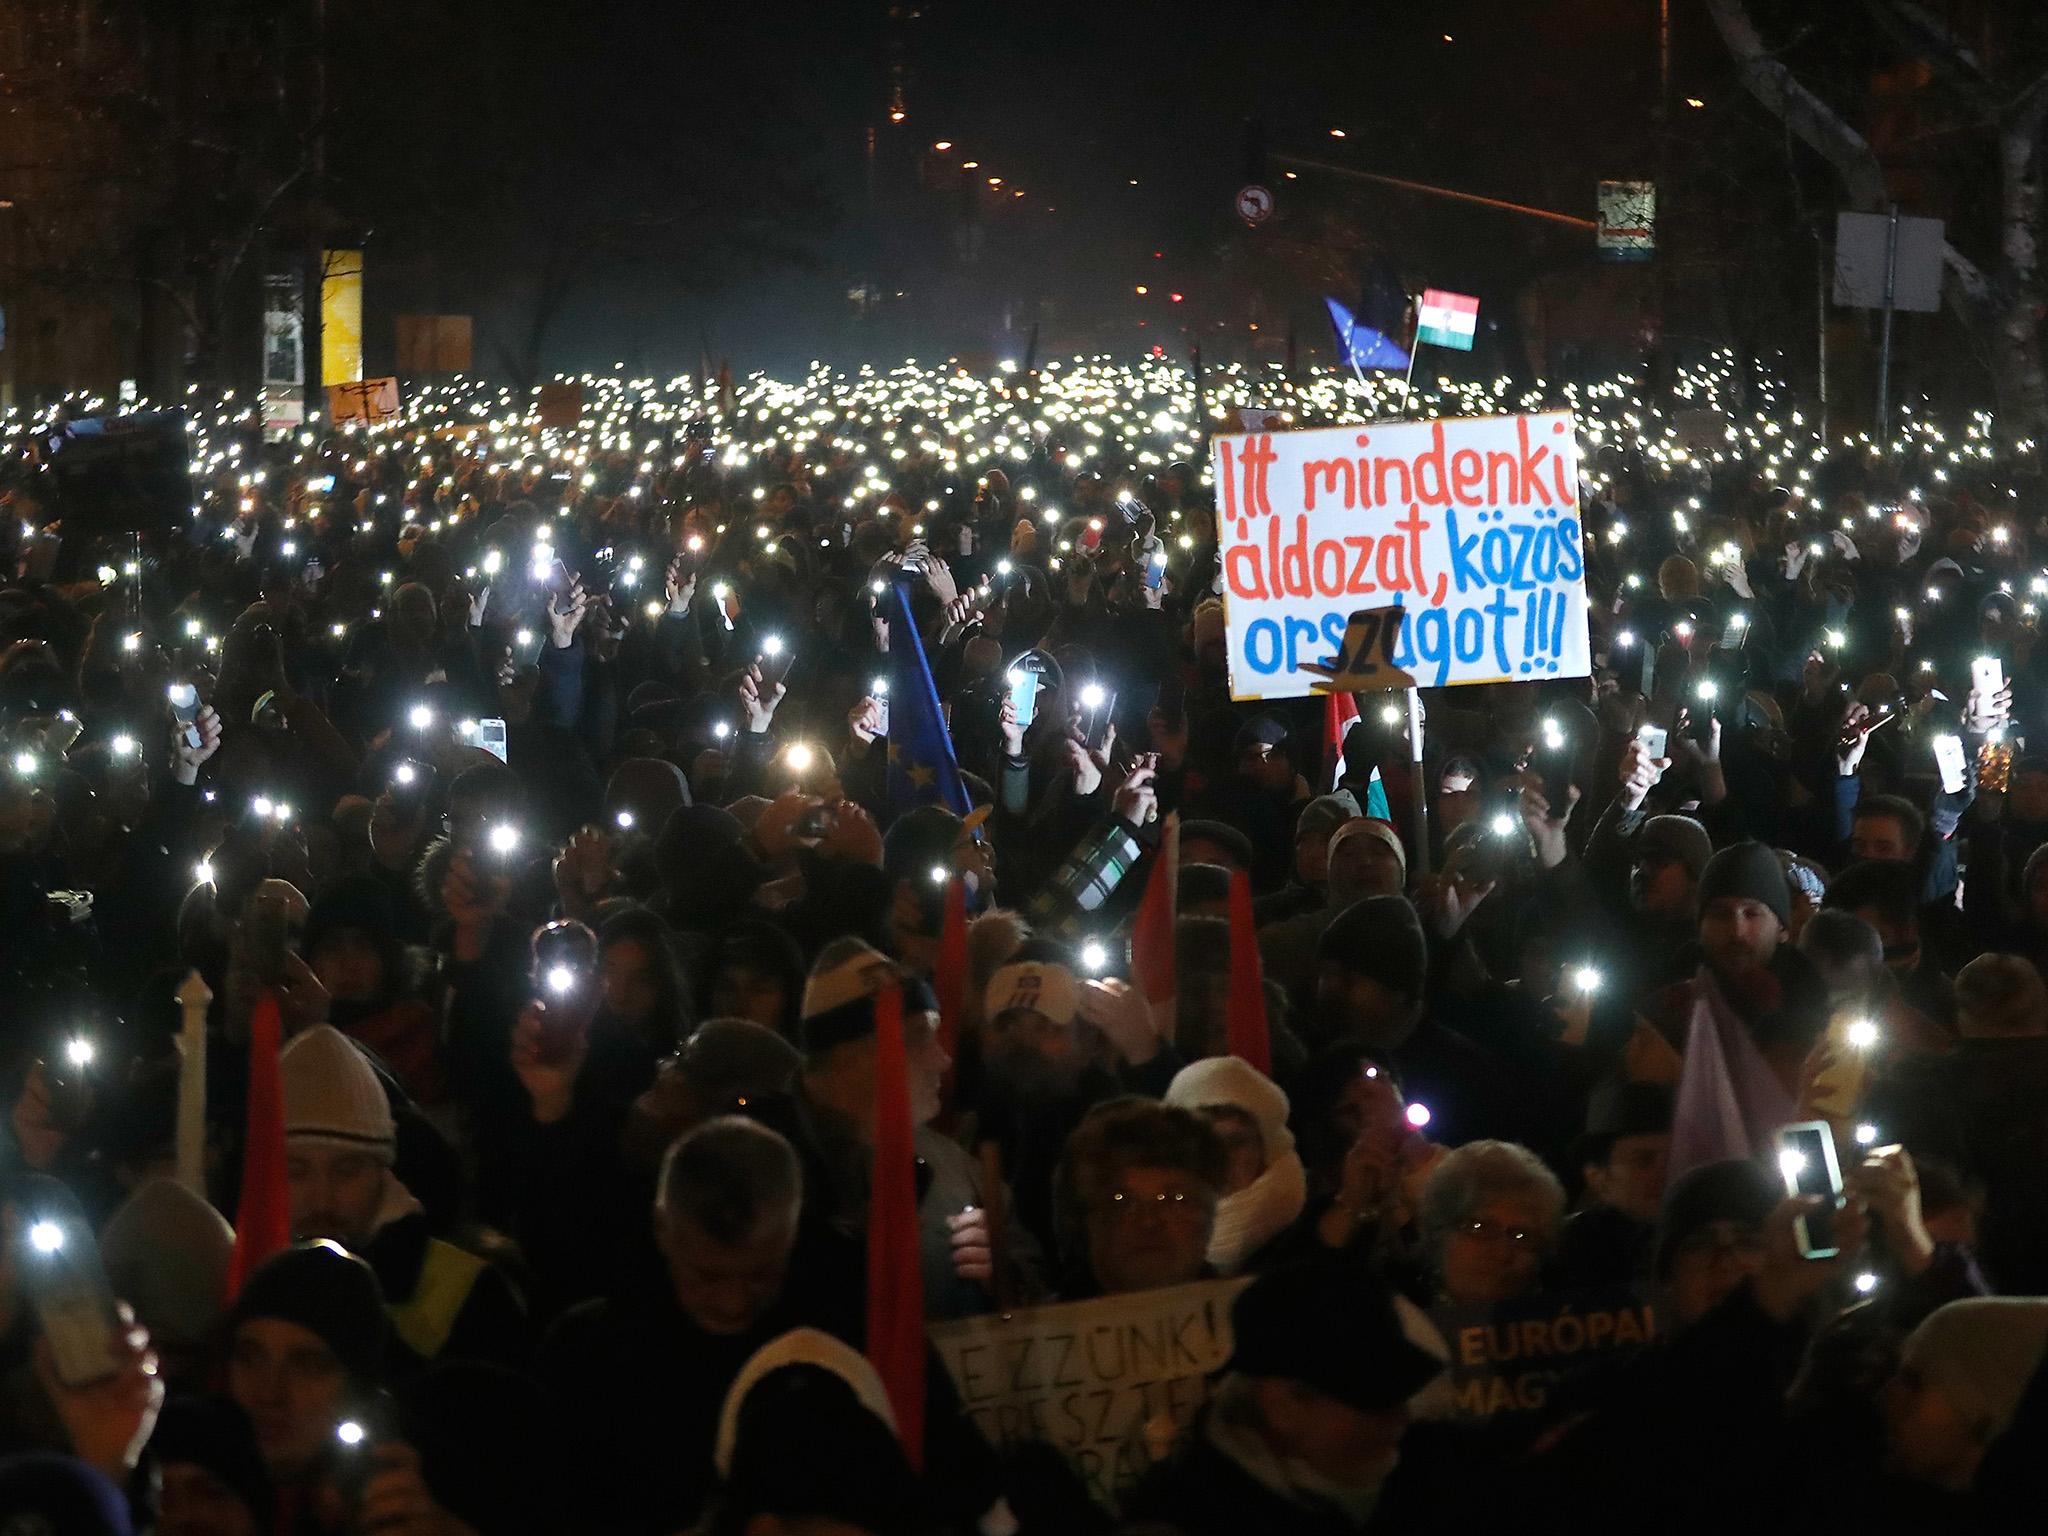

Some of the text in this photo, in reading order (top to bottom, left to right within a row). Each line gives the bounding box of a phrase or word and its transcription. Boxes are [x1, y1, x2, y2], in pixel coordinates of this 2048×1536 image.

[1221, 415, 1575, 522] Itt mindenki
[1225, 503, 1583, 607] áldozat, közös
[1459, 1304, 1656, 1366] EURÓPAI
